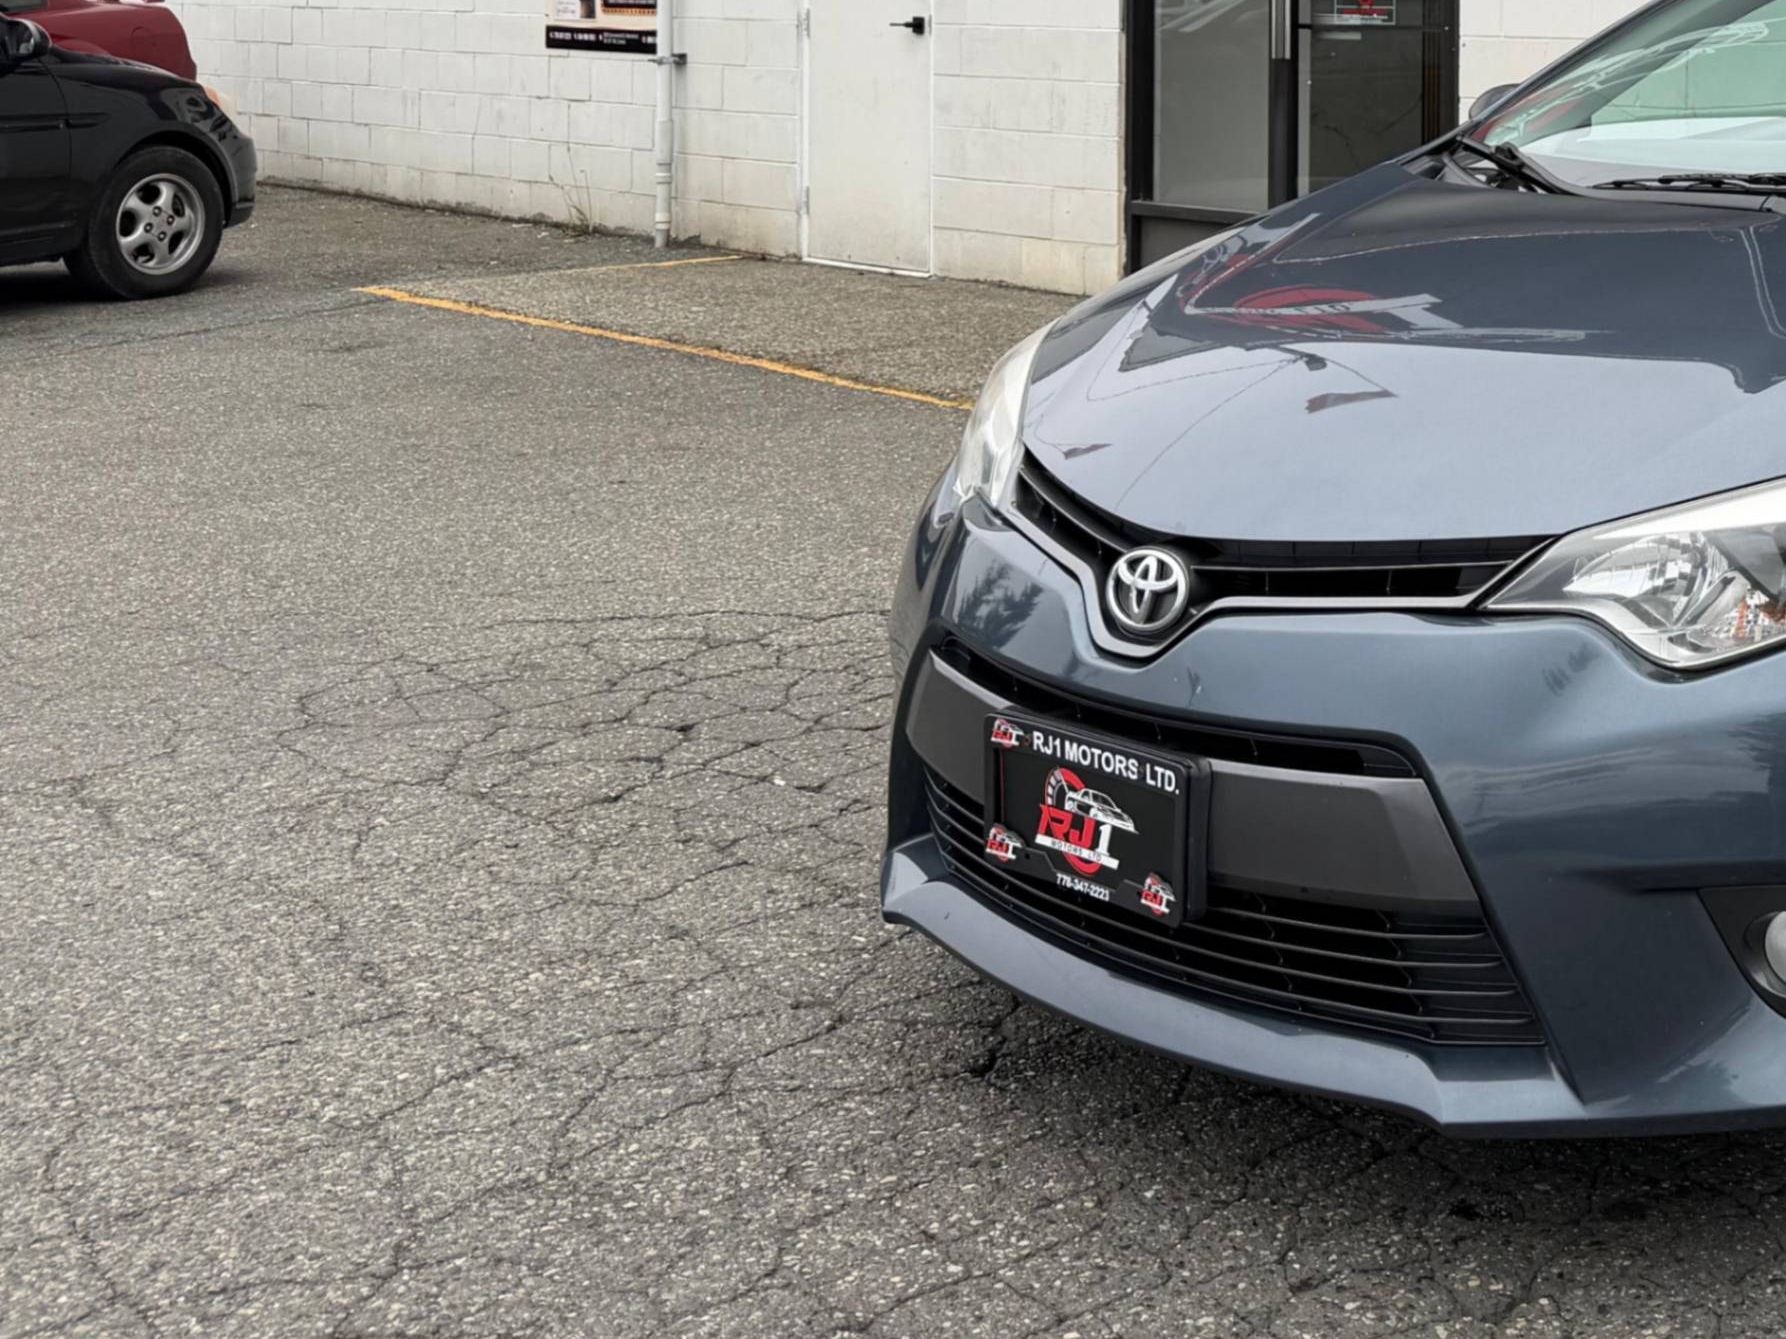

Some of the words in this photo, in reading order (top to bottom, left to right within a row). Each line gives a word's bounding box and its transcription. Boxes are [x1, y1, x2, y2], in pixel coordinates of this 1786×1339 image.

[1032, 730, 1062, 759] RJ1
[1063, 739, 1139, 781] MOTORS
[1145, 762, 1181, 796] LTD.
